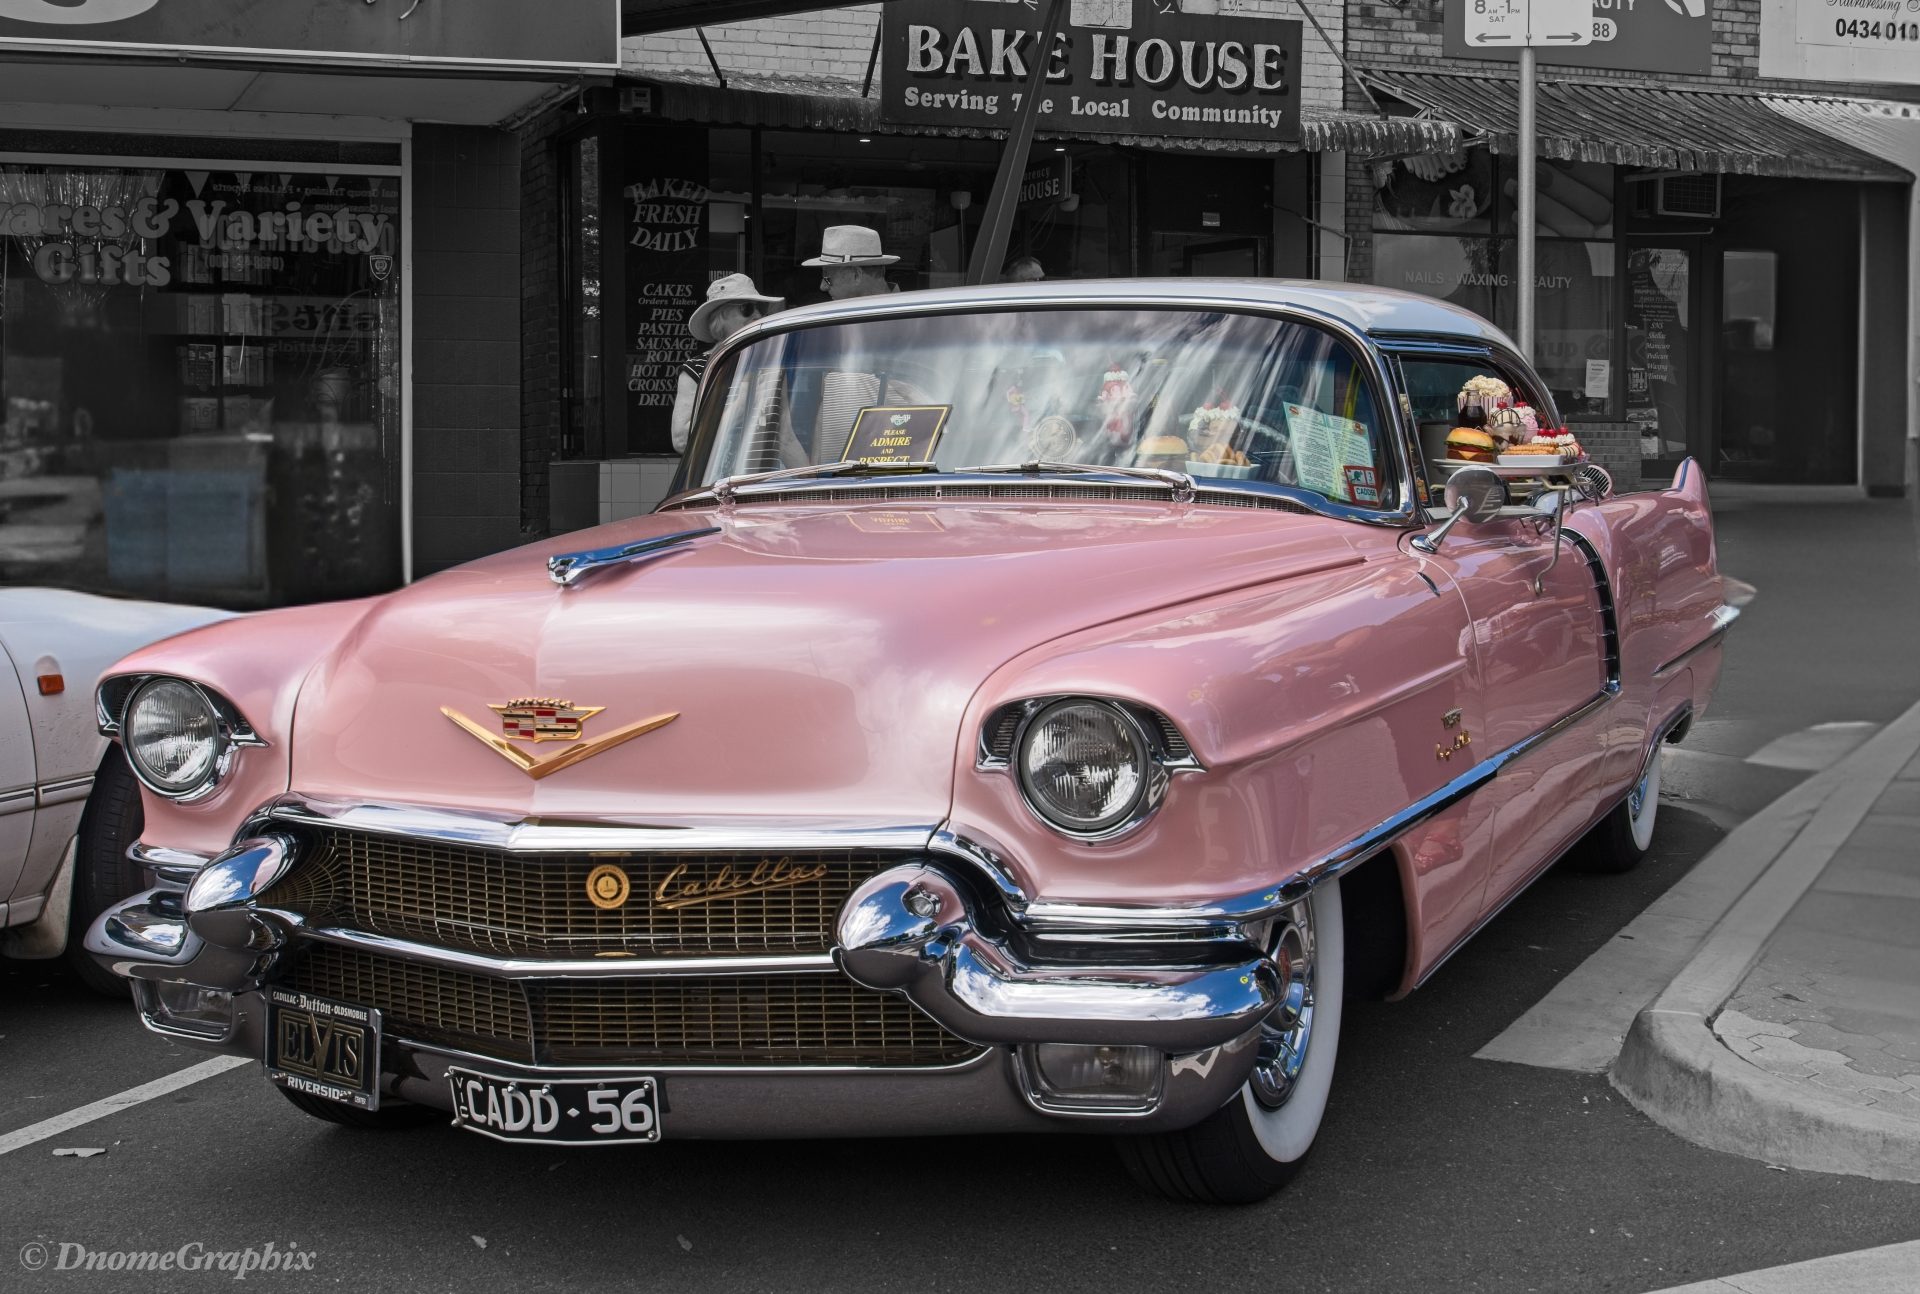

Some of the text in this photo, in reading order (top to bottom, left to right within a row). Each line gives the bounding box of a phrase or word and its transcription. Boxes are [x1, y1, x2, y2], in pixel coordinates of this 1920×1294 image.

[1488, 15, 1505, 23] SAT
[1835, 18, 1881, 39] 0434
[1090, 34, 1282, 89] HOUSE
[904, 86, 999, 113] Serving
[1070, 96, 1130, 118] Local
[1152, 100, 1283, 128] Community
[631, 178, 709, 204] BAKED
[1020, 178, 1060, 202] HOUSE
[0, 202, 126, 237] ares
[132, 198, 179, 238] &
[186, 200, 389, 252] Variety
[632, 204, 702, 225] FRESH
[629, 226, 699, 252] DAILY
[34, 243, 171, 286] Gifts
[643, 283, 693, 297] CAKES
[1405, 271, 1573, 289] NAILS WAXING EAUTY
[638, 297, 697, 306] Orders Taken
[650, 308, 684, 321] PIES
[637, 322, 691, 336] PASTIE
[636, 337, 698, 351] SAUSAGE
[645, 350, 692, 363] ROLLS
[631, 364, 661, 378] HOT
[870, 436, 912, 447] ADMIRE
[883, 428, 907, 436] PLEASE
[656, 856, 828, 903] Cadillac
[273, 991, 368, 1021] CADILLAC Dutton OLDSMOBILE
[282, 1012, 358, 1080] ELVIS
[455, 1076, 470, 1119] VIC
